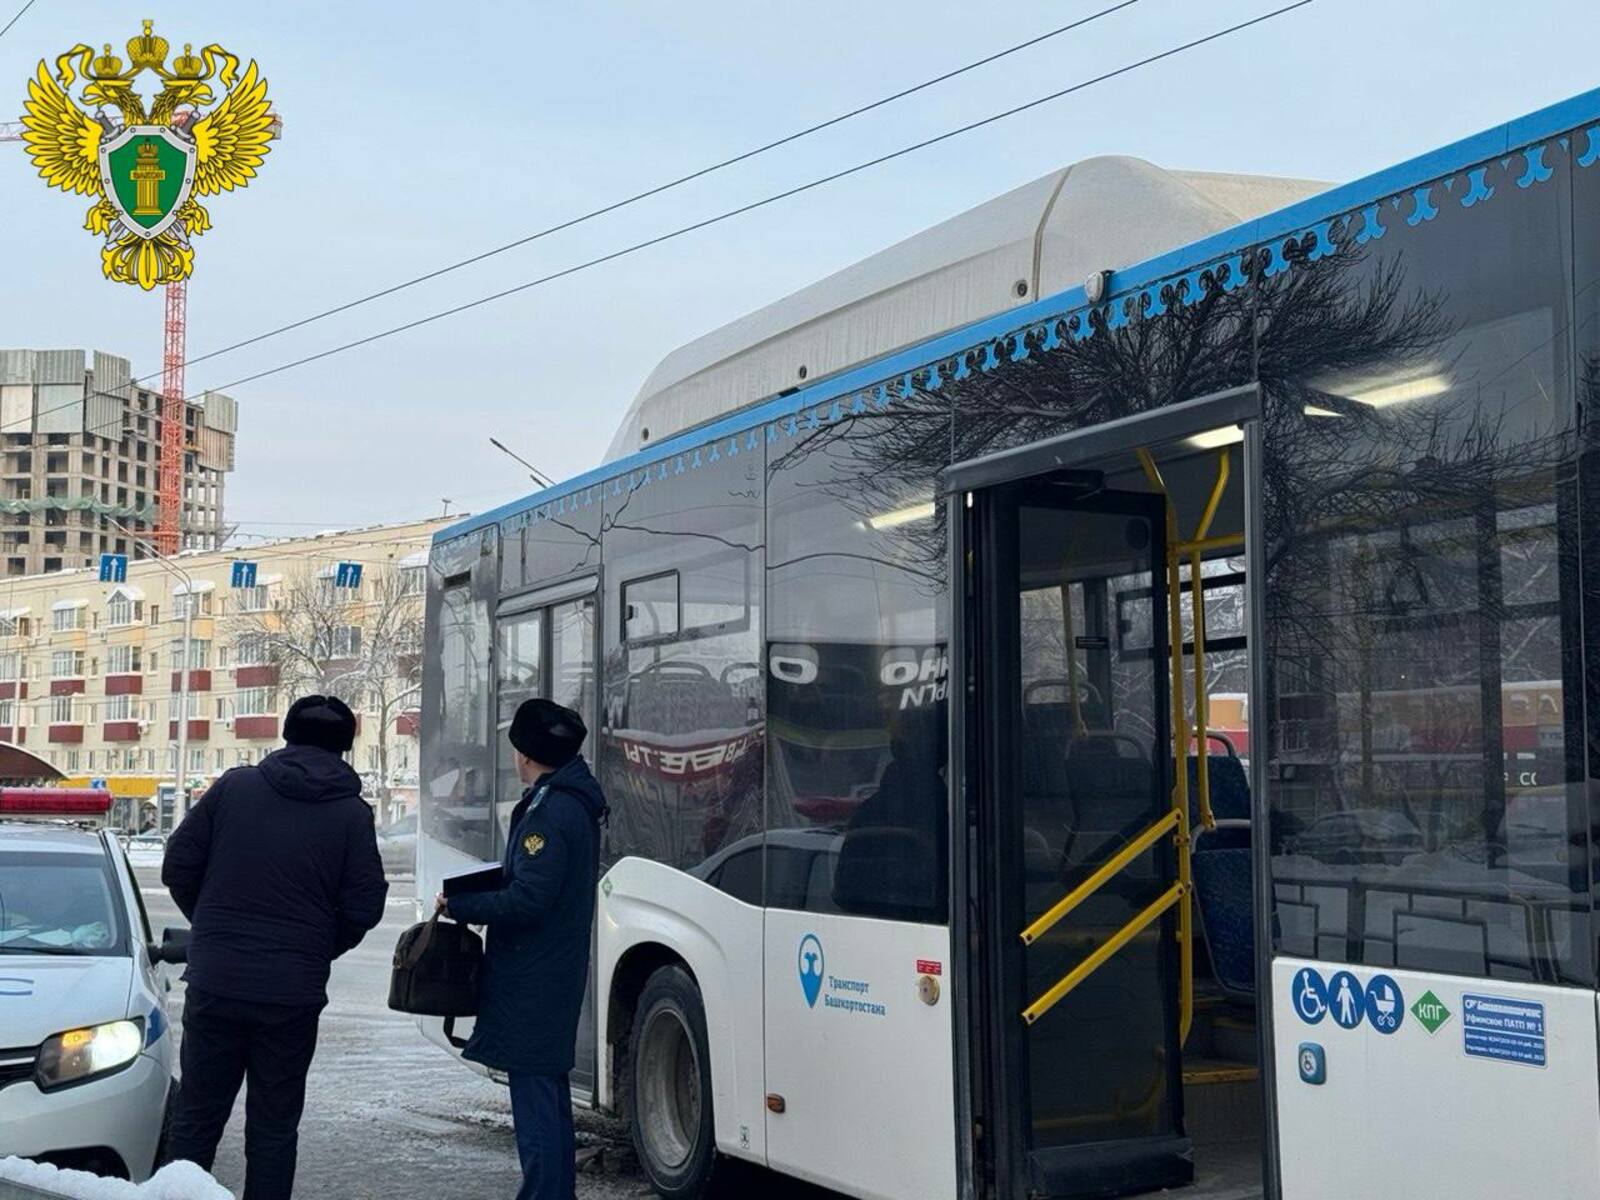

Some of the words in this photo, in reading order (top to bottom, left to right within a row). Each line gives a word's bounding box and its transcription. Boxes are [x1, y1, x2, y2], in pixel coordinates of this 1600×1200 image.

[828, 975, 869, 995] Транспорт
[825, 994, 885, 1016] Башкортостана
[1418, 1003, 1442, 1020] КПГ
[1504, 1018, 1525, 1030] ПАТП
